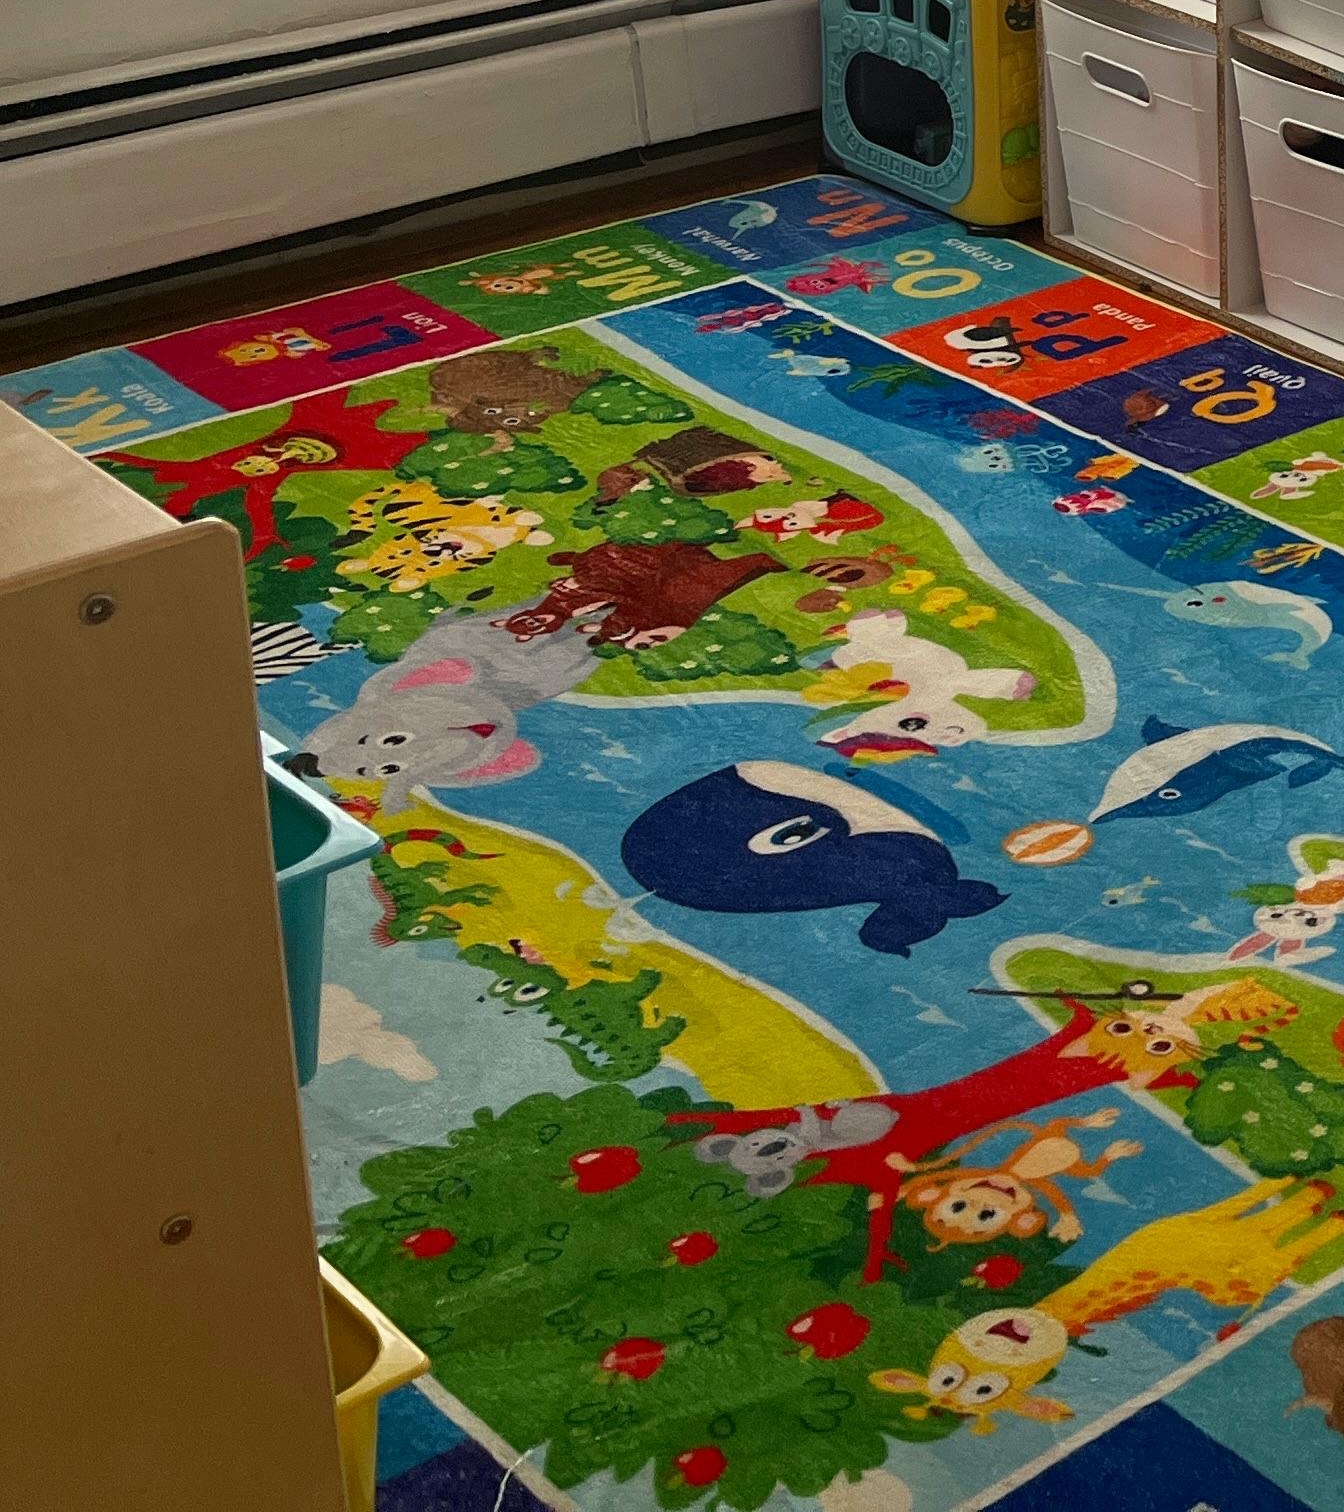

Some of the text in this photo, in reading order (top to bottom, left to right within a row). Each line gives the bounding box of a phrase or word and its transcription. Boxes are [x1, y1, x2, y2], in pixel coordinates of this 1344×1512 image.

[806, 190, 910, 238] Nn
[630, 243, 700, 277] Monkey
[682, 226, 763, 263] Narwhal
[941, 238, 1016, 273] Octopus
[572, 245, 683, 302] Mm
[891, 249, 983, 299] Oo
[401, 311, 449, 335] Lion
[1092, 302, 1158, 332] Panda
[1031, 310, 1130, 362] Pp
[1241, 363, 1308, 390] Quail
[120, 383, 176, 415] Koala
[1179, 367, 1277, 425] Qq
[47, 386, 152, 448] Kk
